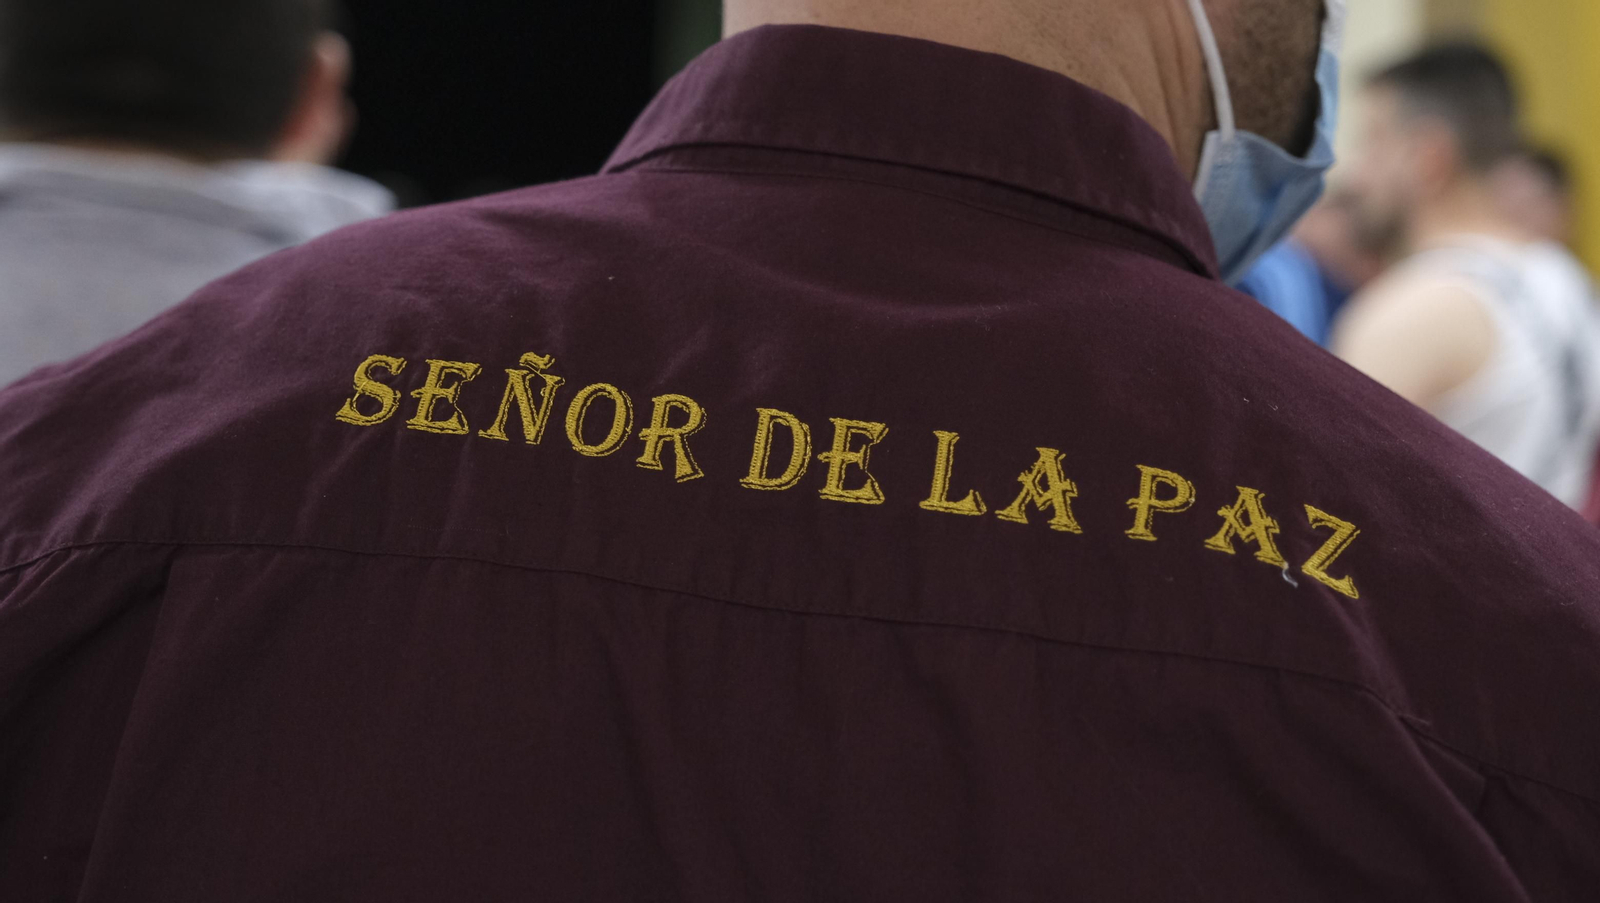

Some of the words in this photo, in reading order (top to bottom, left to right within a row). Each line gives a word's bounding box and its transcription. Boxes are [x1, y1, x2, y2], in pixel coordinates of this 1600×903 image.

[336, 352, 706, 483] SEÑOR
[739, 408, 889, 505] DE
[919, 430, 1083, 534] LA
[1125, 464, 1361, 599] PAZ
